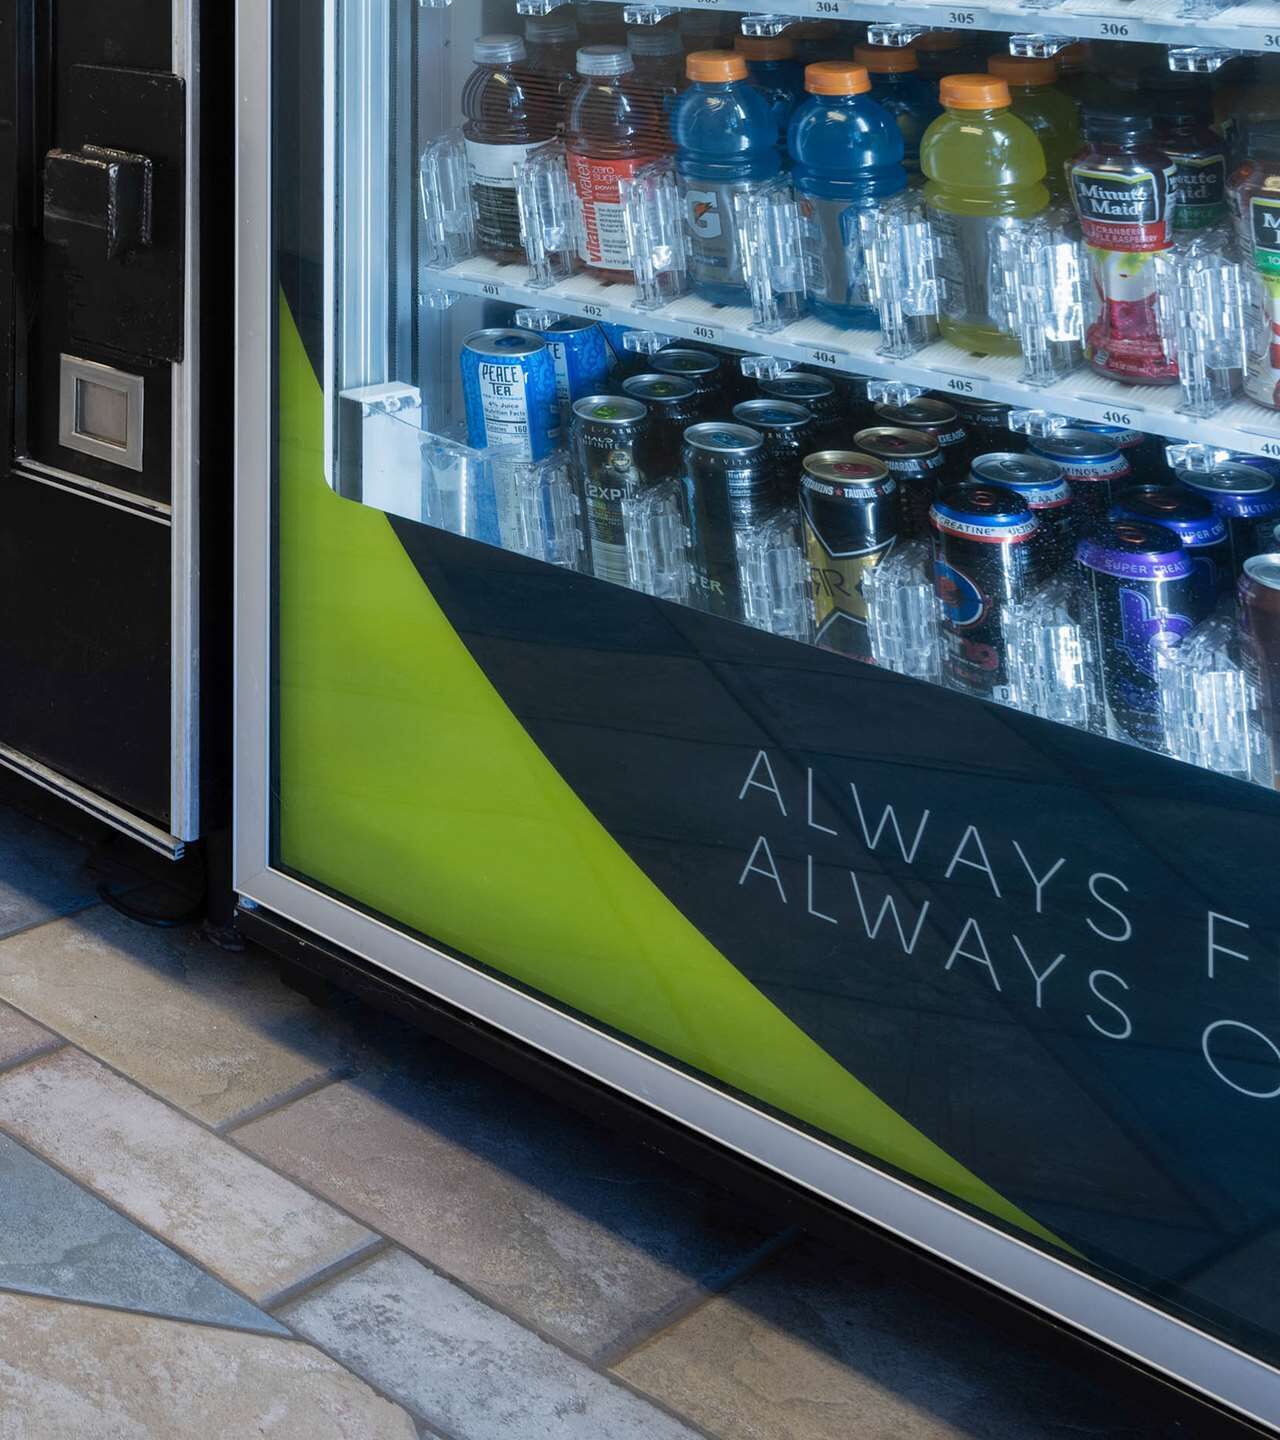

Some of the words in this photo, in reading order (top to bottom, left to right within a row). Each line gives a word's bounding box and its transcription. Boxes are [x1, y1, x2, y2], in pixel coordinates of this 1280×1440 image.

[816, 1, 839, 13] 304
[949, 12, 974, 24] 305
[1100, 23, 1128, 36] 306
[592, 165, 615, 174] zero
[1078, 182, 1148, 201] Minute
[1090, 199, 1145, 216] Maid
[686, 190, 721, 239] G
[482, 284, 500, 296] 401
[583, 305, 603, 317] 402
[694, 326, 715, 339] 403
[812, 350, 836, 365] 404
[482, 364, 519, 383] PEACE
[489, 383, 513, 396] TEA
[948, 379, 973, 393] 405
[1103, 409, 1131, 425] 406
[514, 425, 527, 433] 160
[584, 434, 613, 444] HALO
[843, 488, 878, 499] TAURINE
[1104, 559, 1147, 574] SUPER
[739, 749, 1132, 942] ALWAYS
[739, 835, 1132, 1040] ALWAYS
